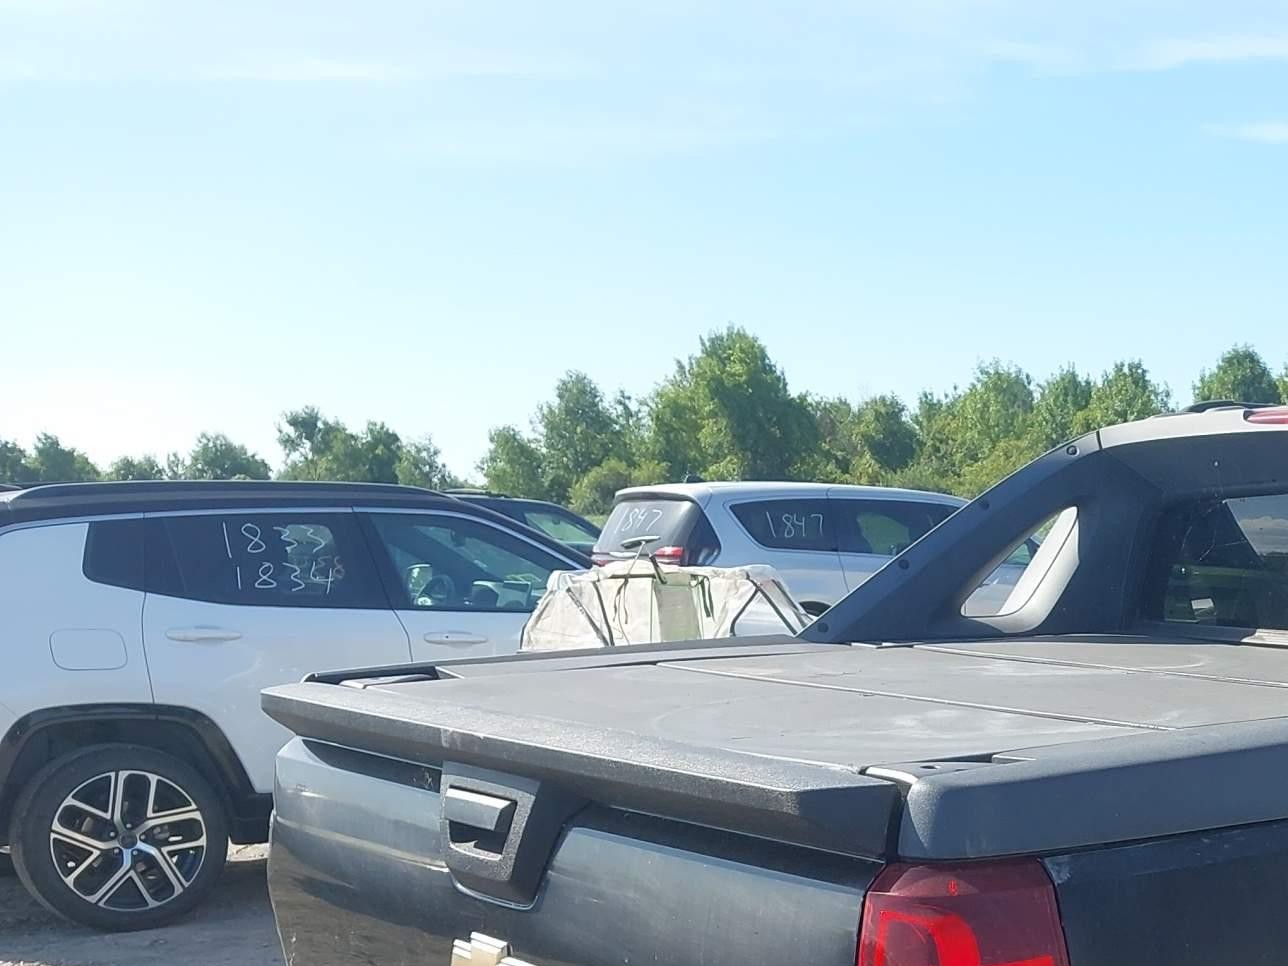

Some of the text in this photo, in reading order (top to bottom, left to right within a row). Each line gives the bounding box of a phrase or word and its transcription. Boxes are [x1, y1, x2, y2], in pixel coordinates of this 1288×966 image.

[614, 506, 663, 534] 1847
[765, 511, 823, 538] 1847
[222, 521, 325, 558] 1833
[236, 561, 334, 594] 1834
